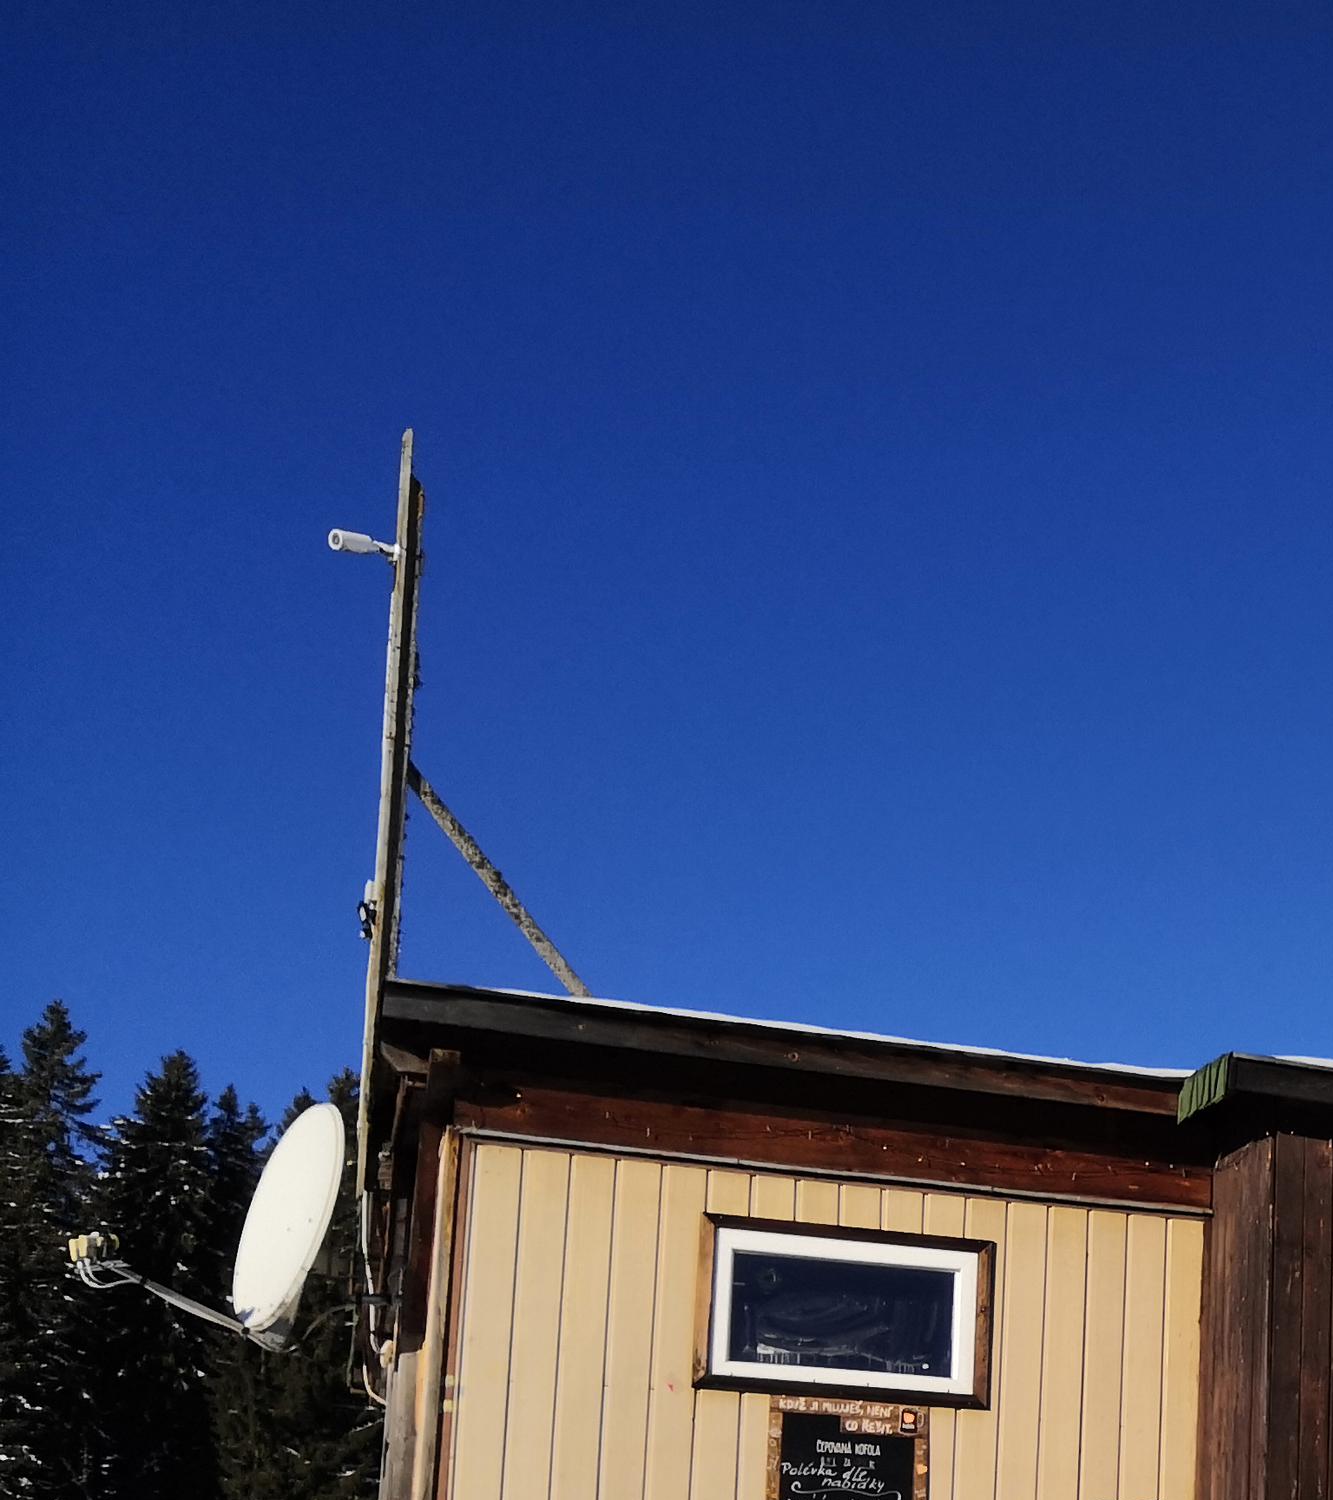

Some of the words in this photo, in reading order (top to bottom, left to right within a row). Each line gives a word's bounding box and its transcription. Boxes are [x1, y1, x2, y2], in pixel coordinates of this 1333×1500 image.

[845, 1420, 859, 1432] CO
[855, 1443, 881, 1456] KOFOLA
[781, 1460, 838, 1476] Polévka
